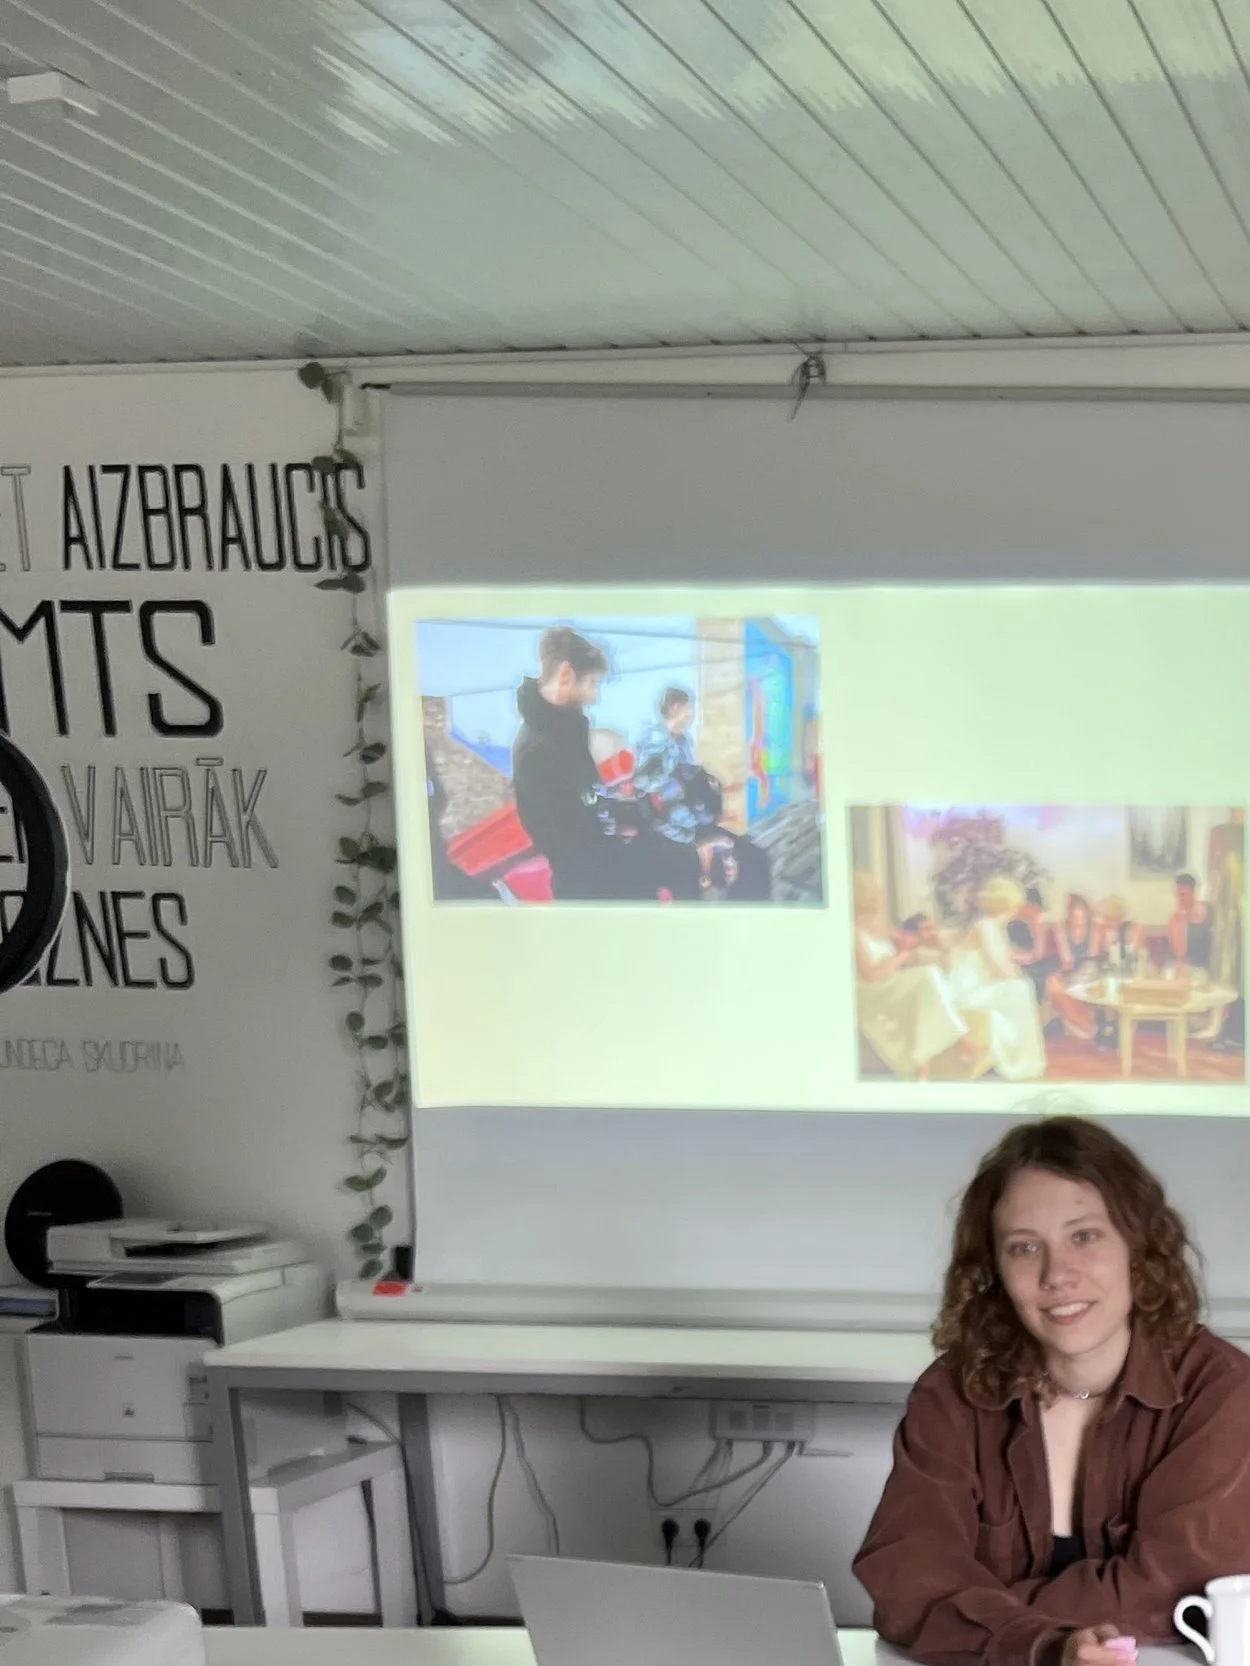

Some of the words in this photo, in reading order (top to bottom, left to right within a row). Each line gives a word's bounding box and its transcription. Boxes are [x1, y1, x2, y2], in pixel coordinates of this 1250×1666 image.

[62, 462, 373, 572] AIZBRAUCIS
[60, 756, 279, 868] VAIRĀK
[0, 1038, 76, 1072] NDEGA
